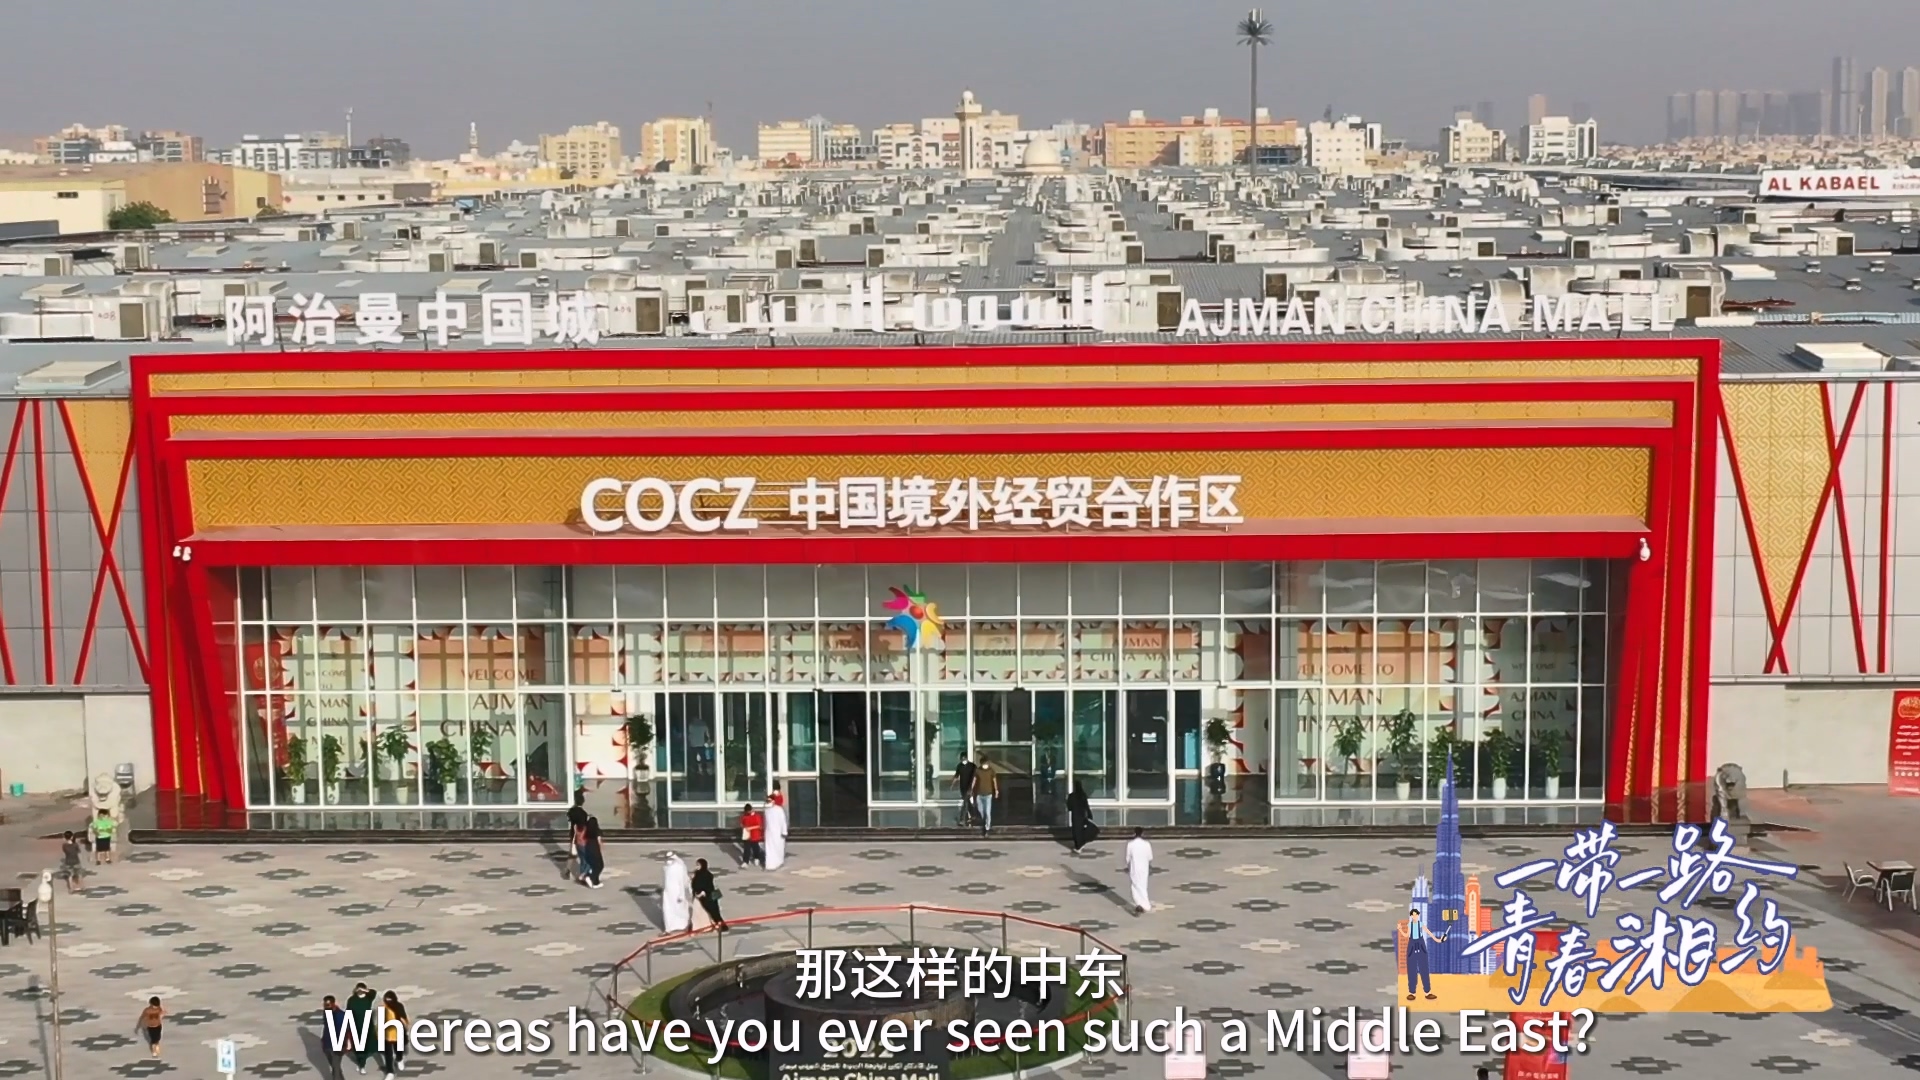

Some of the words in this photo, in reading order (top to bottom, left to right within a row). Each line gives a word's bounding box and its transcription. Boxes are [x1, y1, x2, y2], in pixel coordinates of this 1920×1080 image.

[1768, 177, 1792, 191] AL
[1800, 176, 1880, 191] KABAEL
[224, 291, 602, 346] 阿治曼中国城
[1176, 296, 1347, 338] AJMAN
[1361, 293, 1511, 334] CHINA
[1532, 292, 1675, 332] MALL
[580, 477, 759, 532] COCZ
[789, 474, 1244, 530] 中国境外经贸合作区
